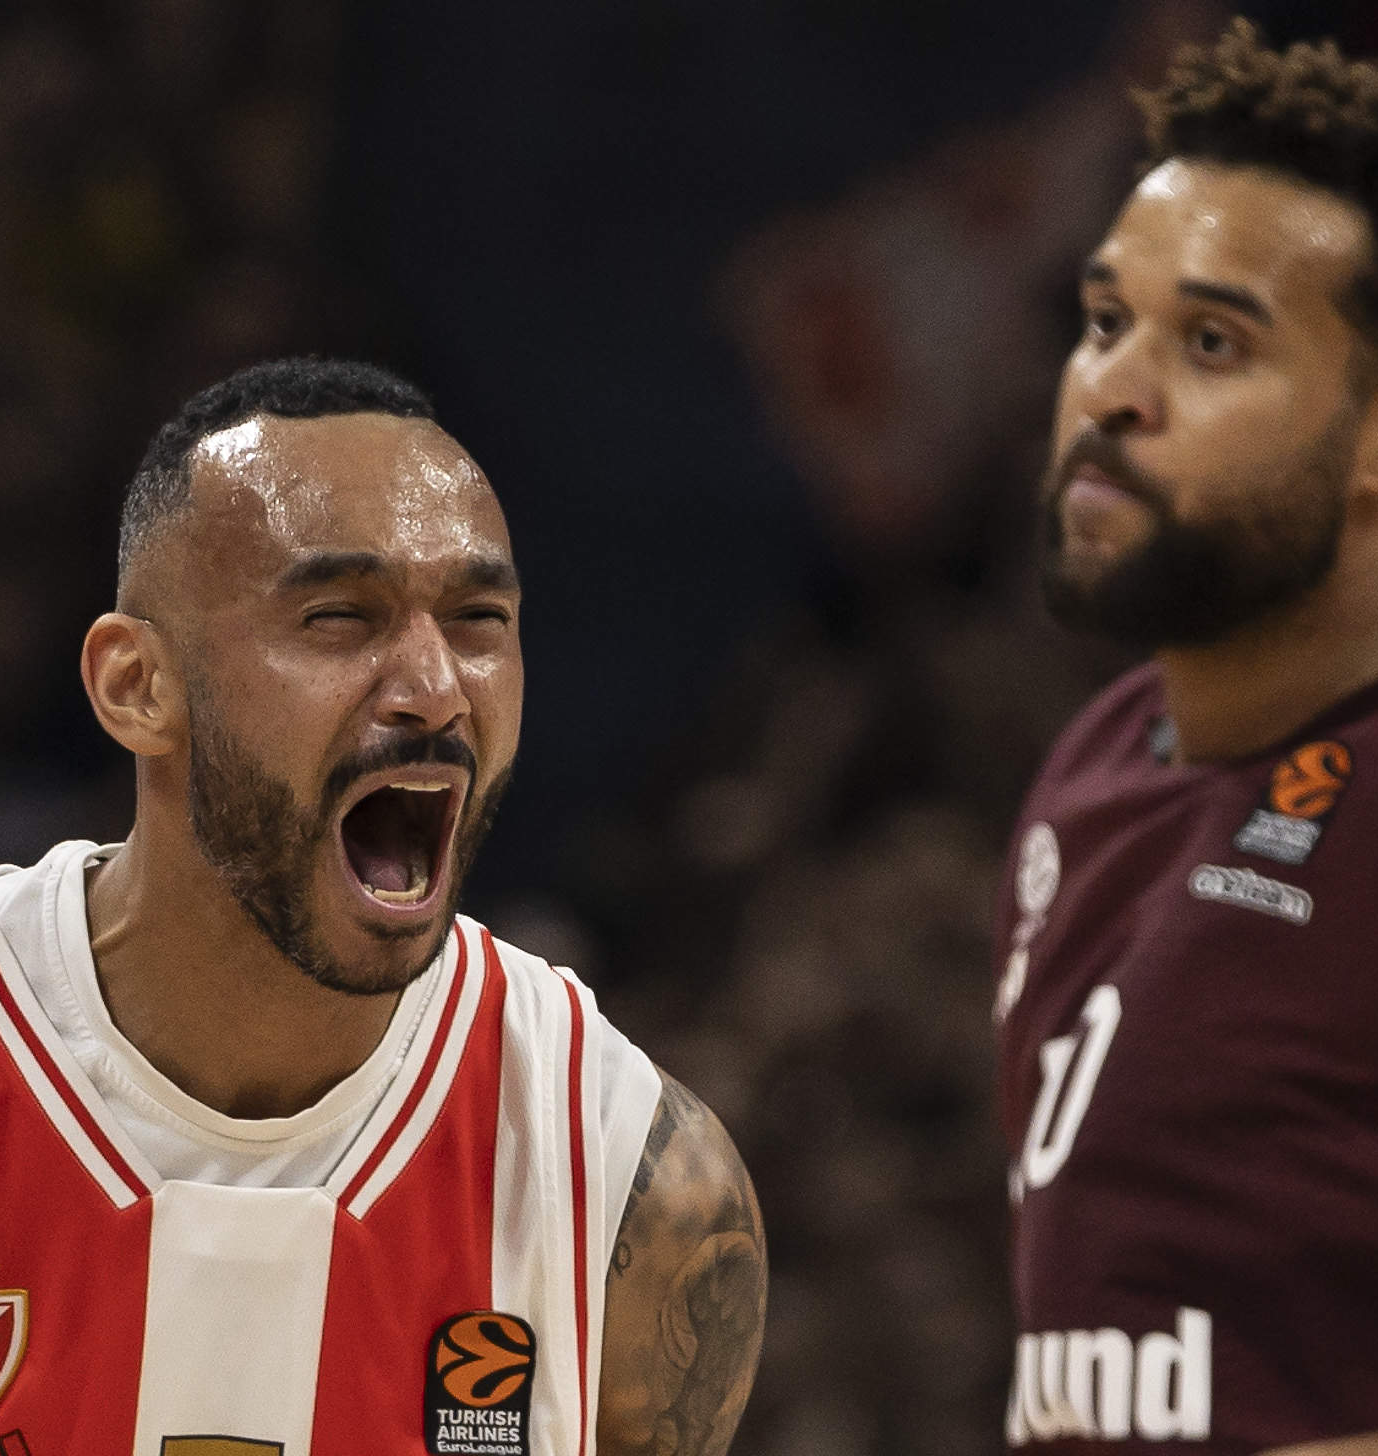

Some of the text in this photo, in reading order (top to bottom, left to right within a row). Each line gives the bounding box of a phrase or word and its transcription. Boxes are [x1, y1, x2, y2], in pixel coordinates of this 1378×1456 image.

[1006, 1306, 1213, 1447] und
[437, 1409, 521, 1427] TURKISH
[437, 1426, 521, 1443] AIRLINES
